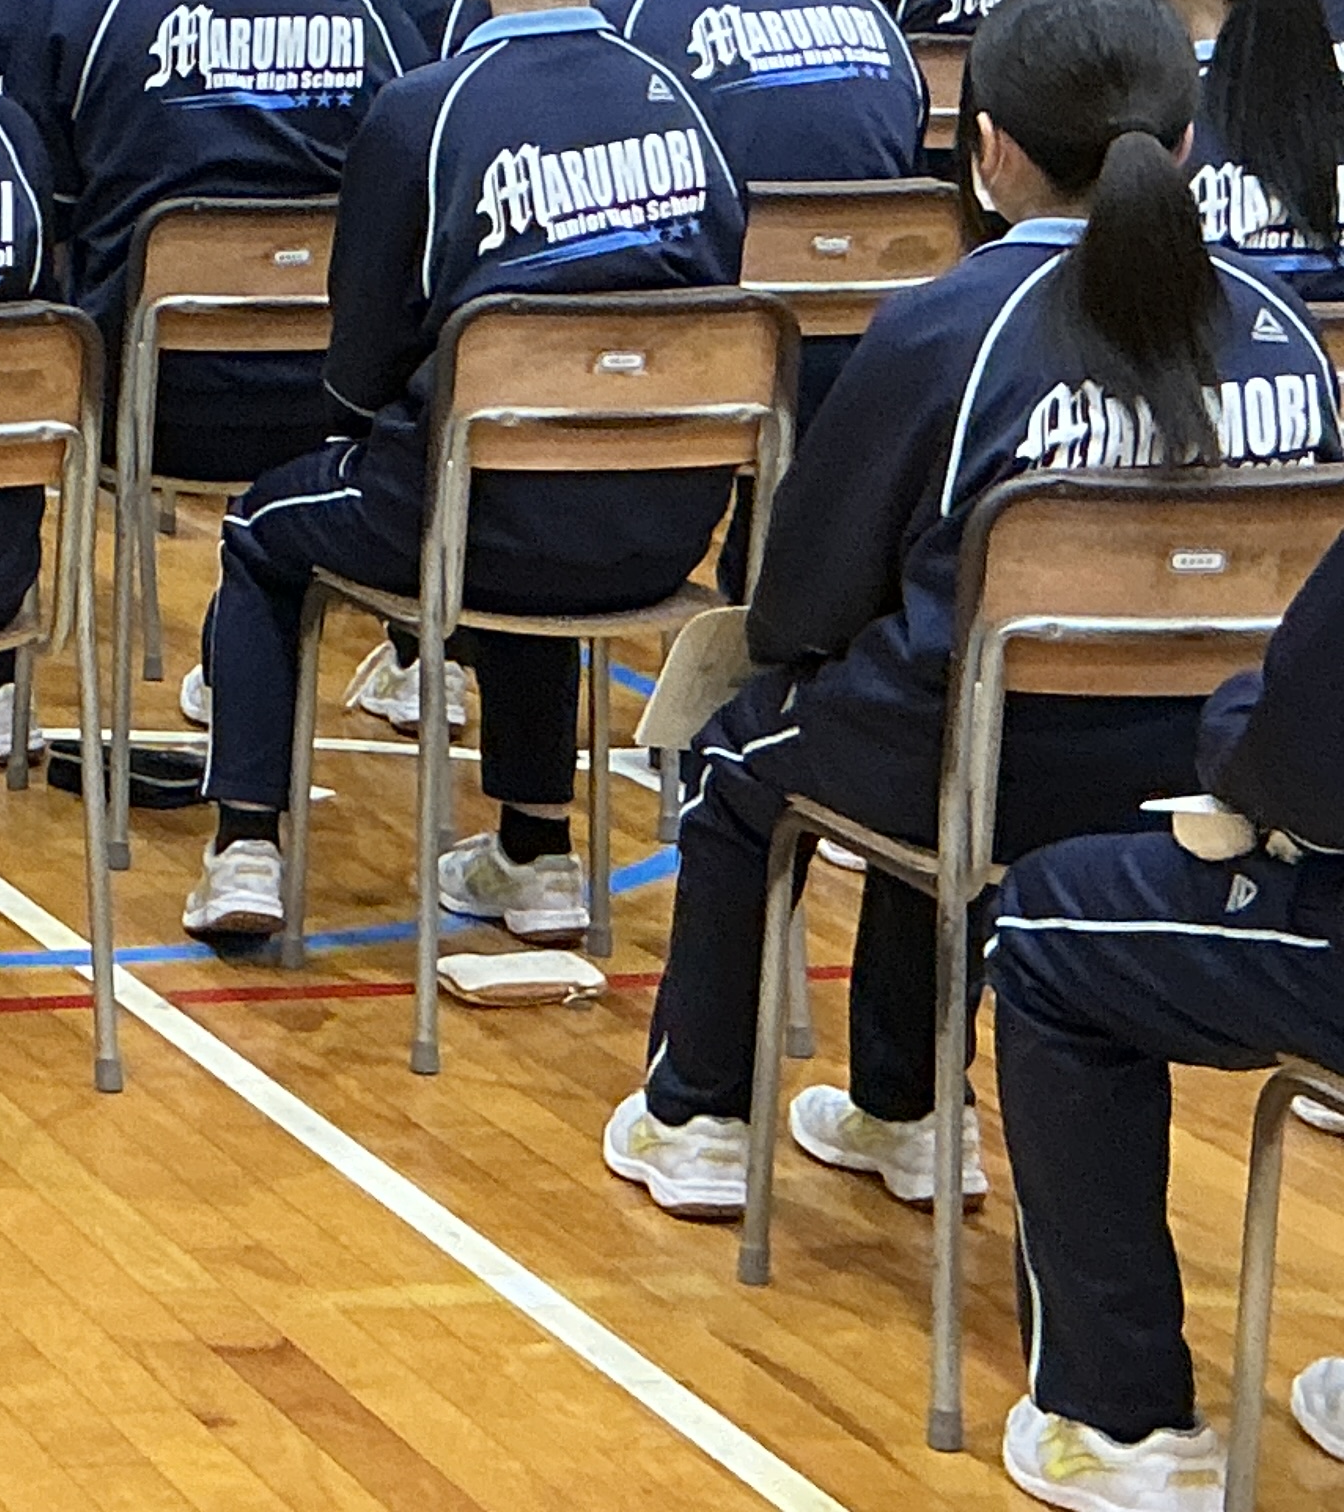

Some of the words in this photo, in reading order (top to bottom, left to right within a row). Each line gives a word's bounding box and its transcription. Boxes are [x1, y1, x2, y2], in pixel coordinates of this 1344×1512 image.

[143, 4, 364, 92] MARUMORI
[686, 4, 888, 80] MARUMORI
[205, 72, 255, 90] Junior
[256, 71, 299, 92] High
[300, 69, 364, 89] School
[475, 128, 707, 257] MARUMORI
[546, 209, 607, 244] Junior
[646, 191, 707, 222] School
